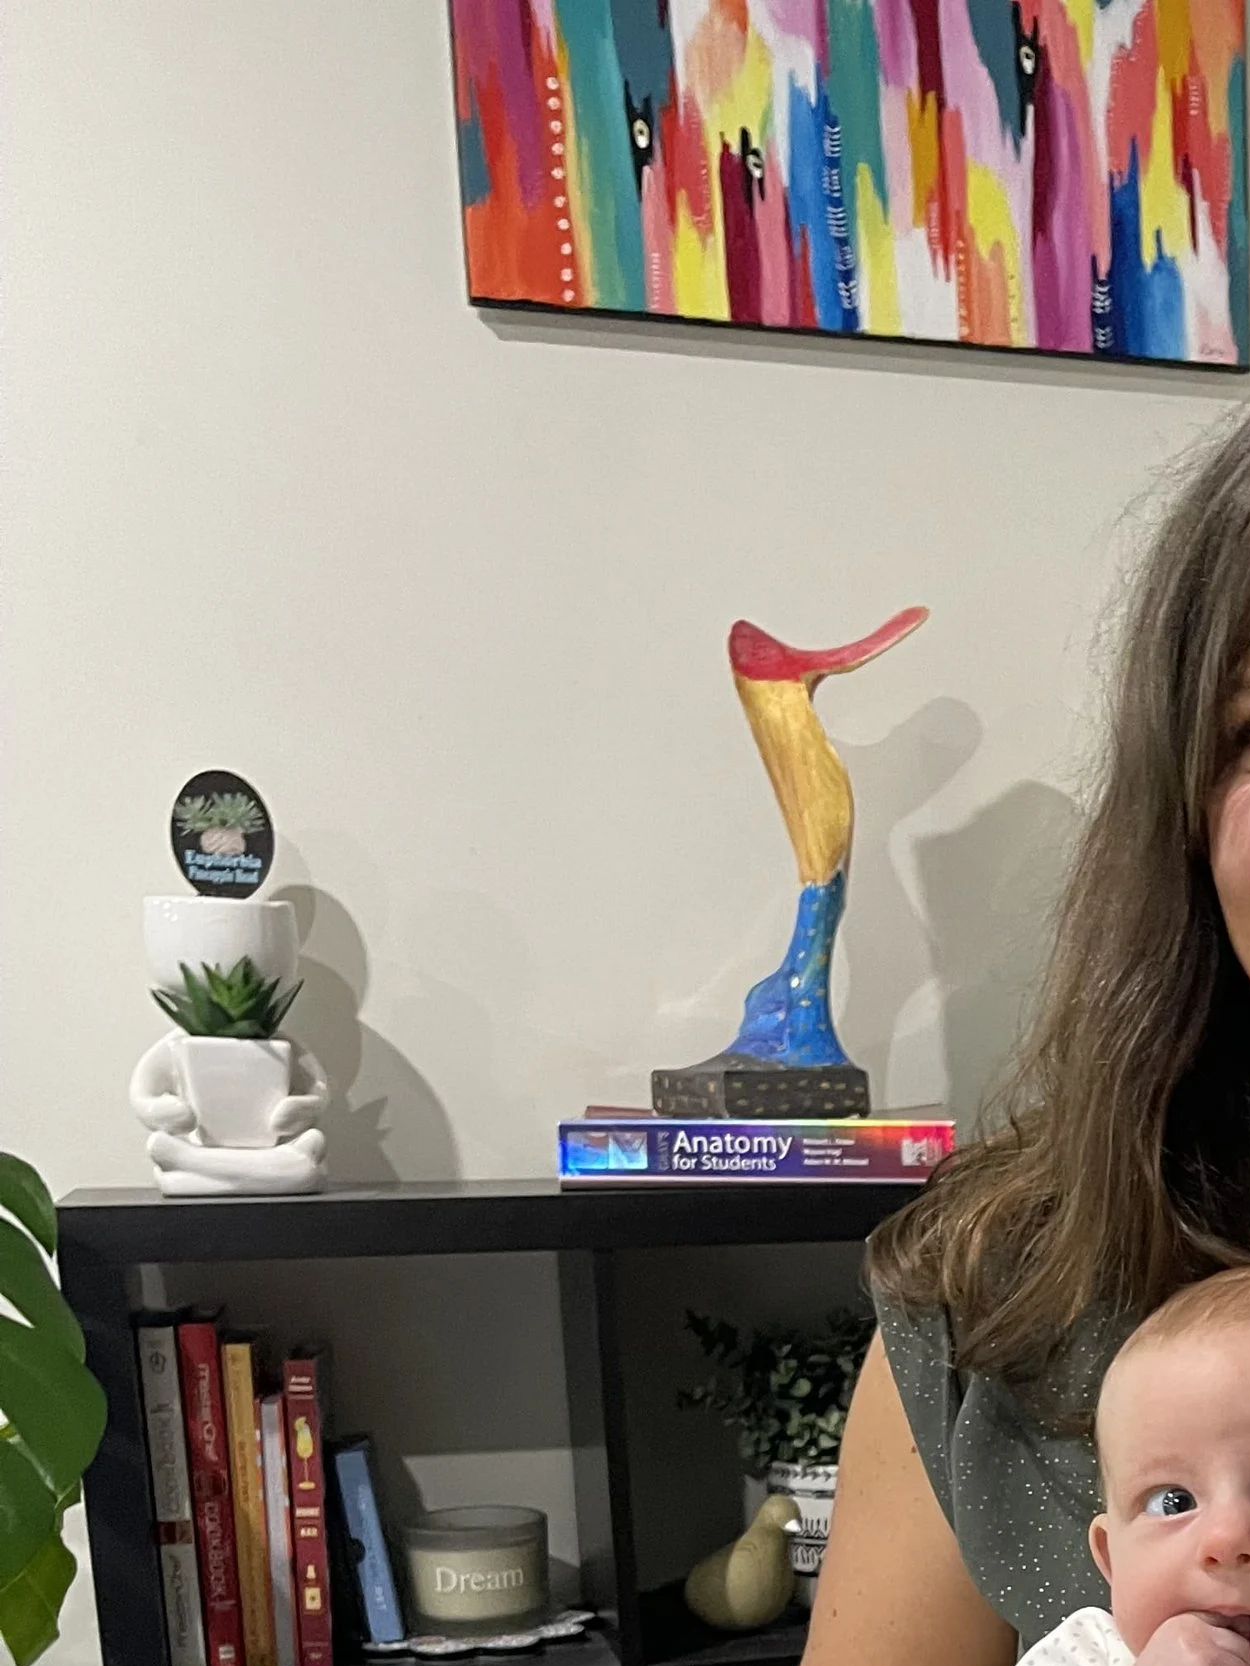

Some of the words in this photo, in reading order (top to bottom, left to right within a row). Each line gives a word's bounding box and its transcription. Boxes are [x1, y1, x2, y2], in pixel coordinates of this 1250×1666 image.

[673, 1130, 793, 1160] Anatomy
[672, 1154, 698, 1170] for
[701, 1155, 776, 1171] Students
[434, 1566, 525, 1594] Dream
